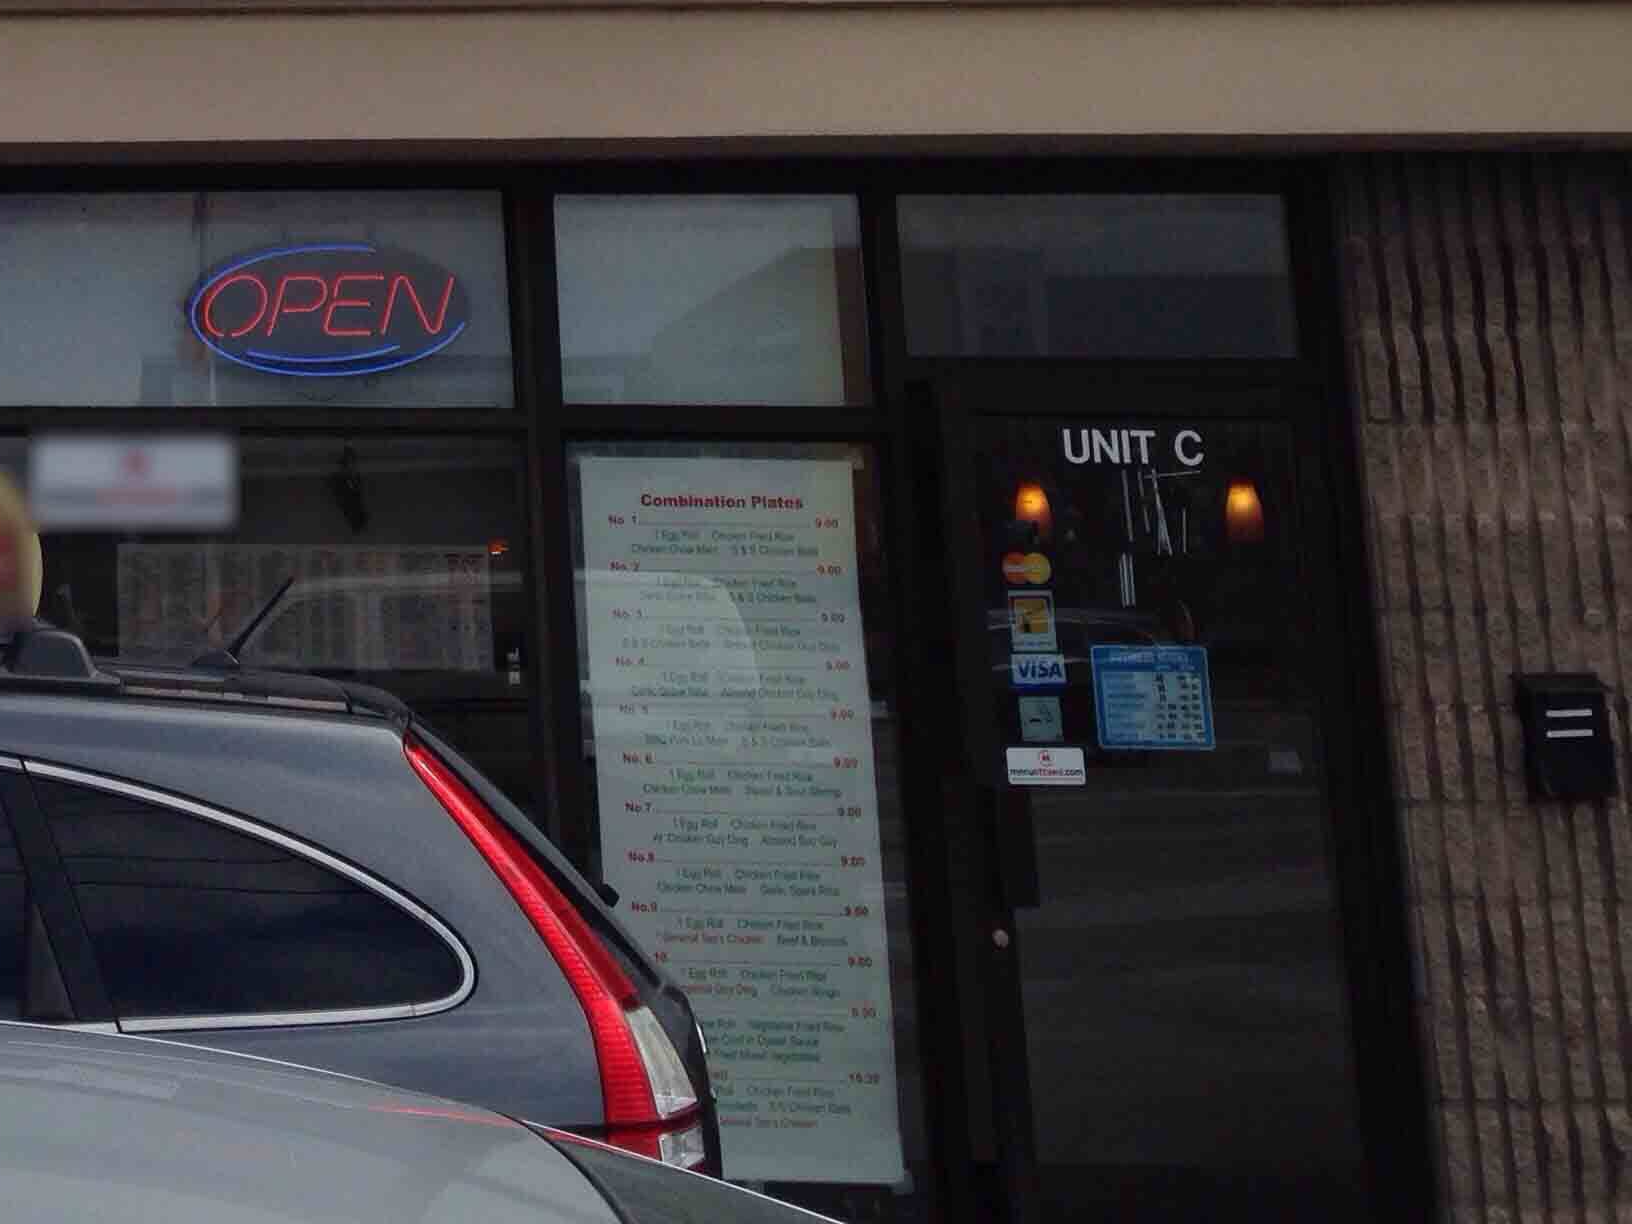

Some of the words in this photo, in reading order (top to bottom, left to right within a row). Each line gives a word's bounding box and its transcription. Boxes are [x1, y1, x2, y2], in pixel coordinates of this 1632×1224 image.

[200, 273, 456, 338] OPEN
[1062, 429, 1156, 464] UNIT
[1174, 429, 1205, 466] C
[640, 494, 746, 509] Combination
[751, 496, 803, 511] Plates
[1018, 663, 1064, 679] VISA
